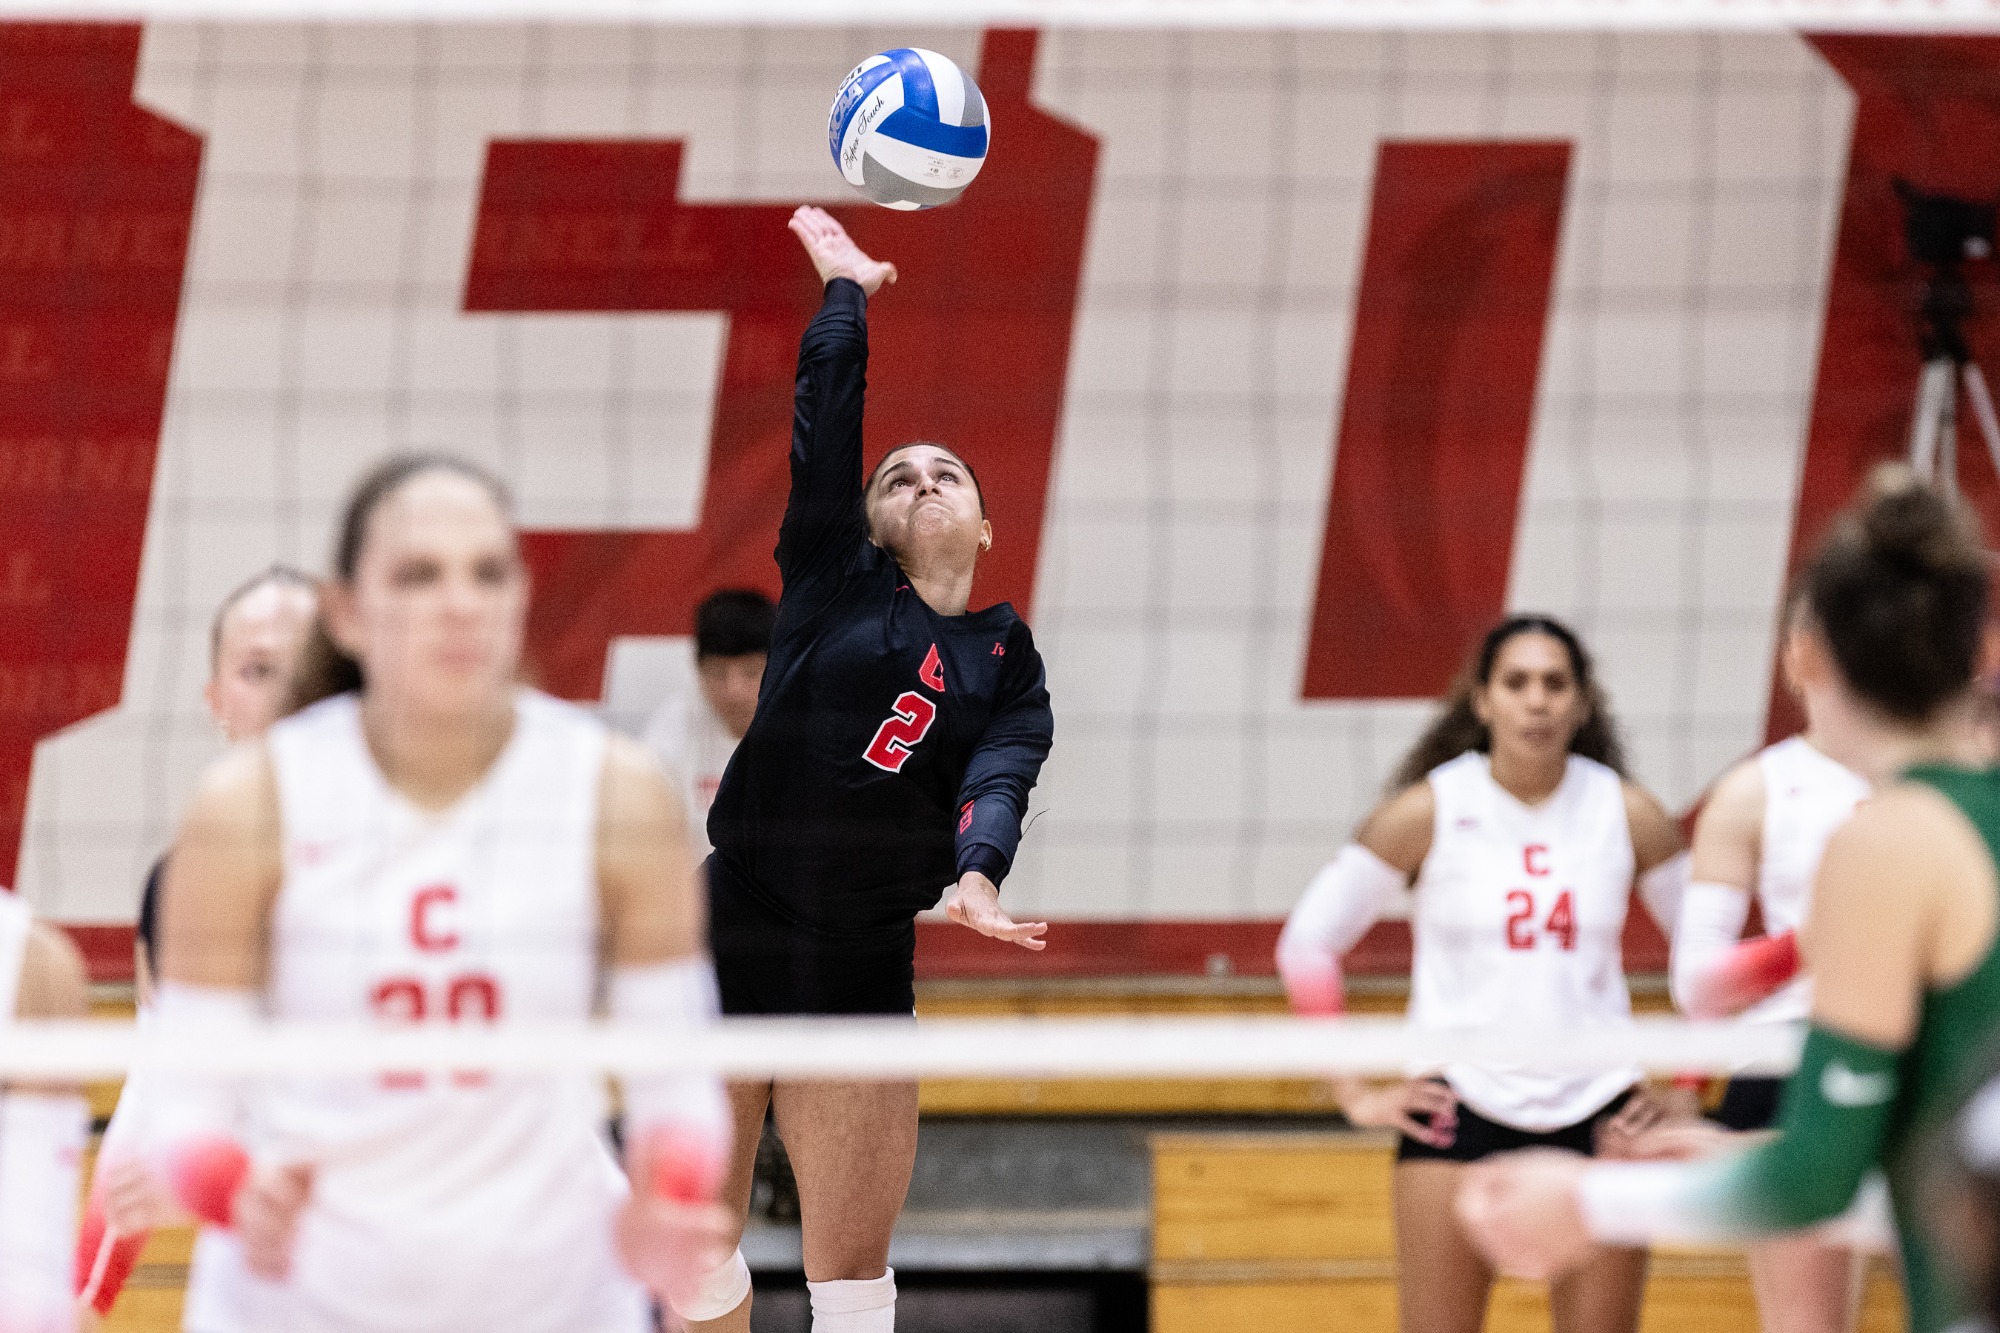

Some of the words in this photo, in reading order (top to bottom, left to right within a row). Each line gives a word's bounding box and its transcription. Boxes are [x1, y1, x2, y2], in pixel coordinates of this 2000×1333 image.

[842, 136, 860, 171] Super
[857, 95, 885, 136] Touch
[862, 690, 937, 773] 2
[1522, 843, 1551, 877] C
[408, 882, 462, 954] C
[1505, 888, 1577, 951] 24
